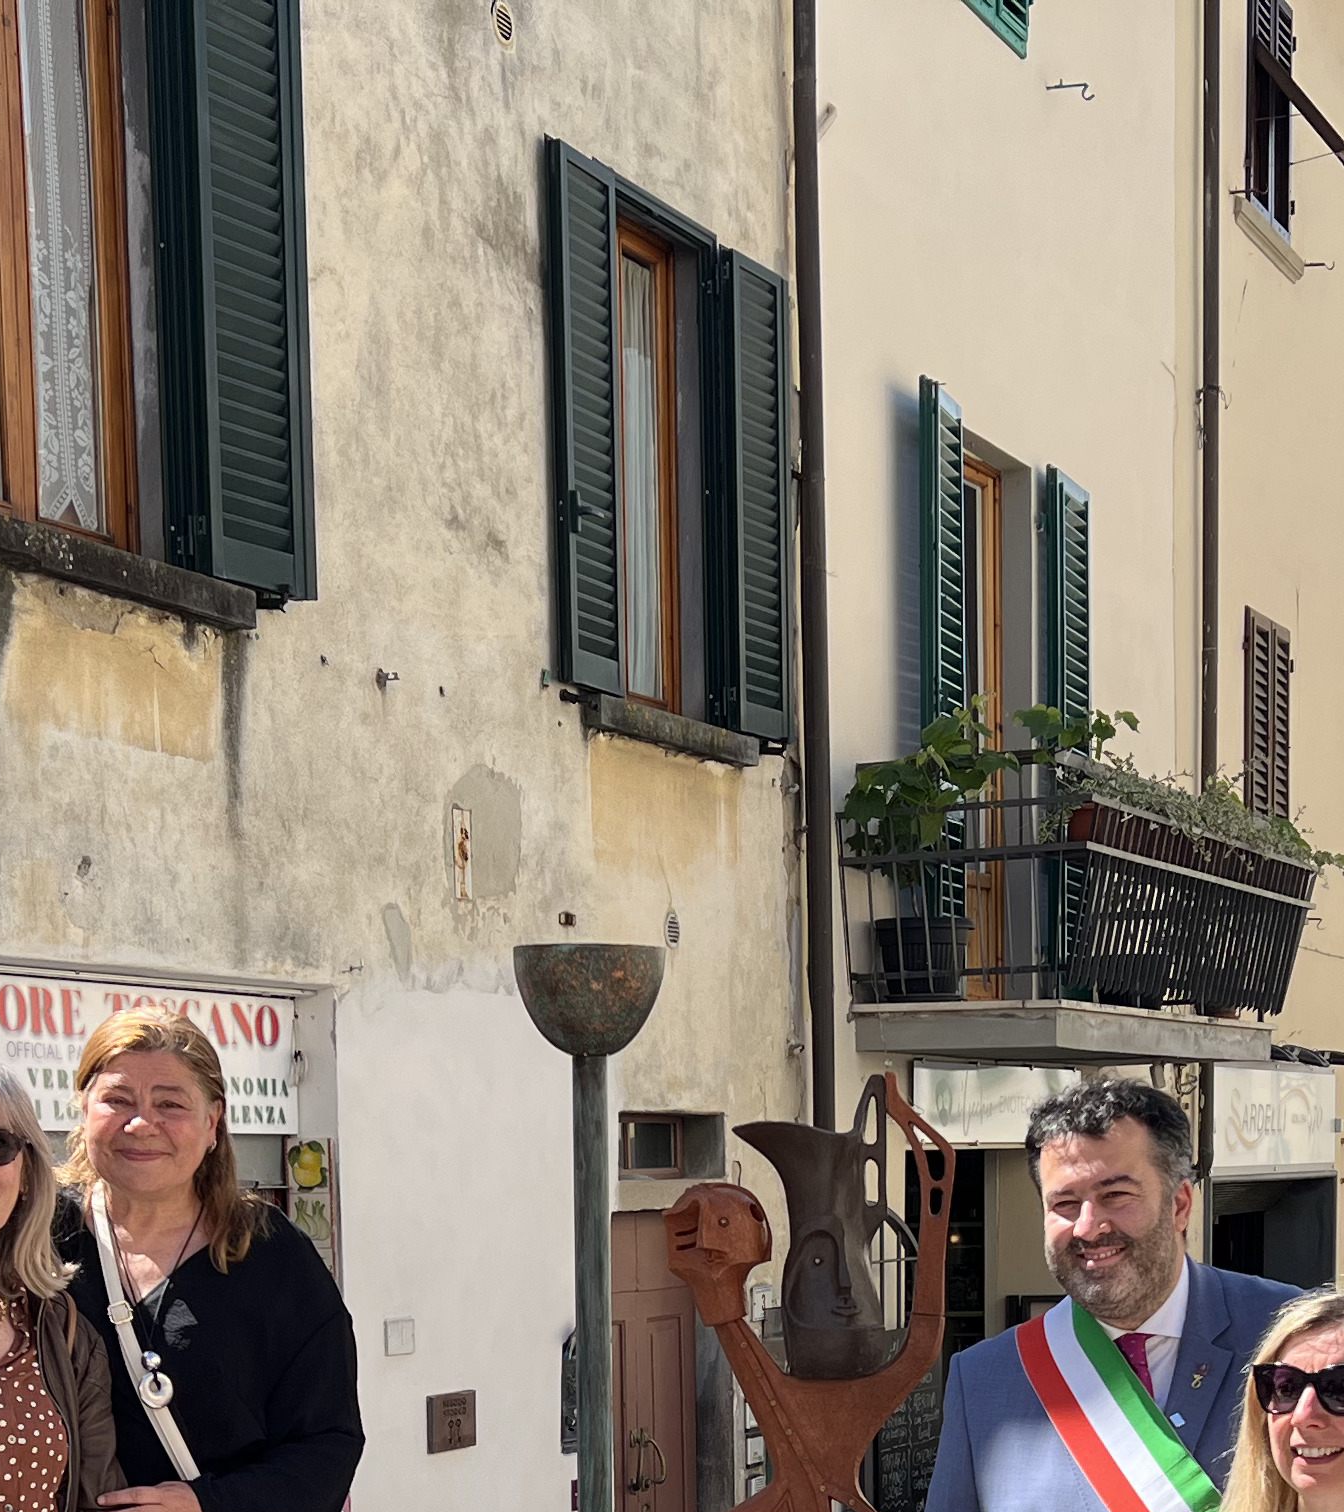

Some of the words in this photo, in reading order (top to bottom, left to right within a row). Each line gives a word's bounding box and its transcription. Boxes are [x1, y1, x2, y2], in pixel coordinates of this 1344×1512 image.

[6, 1040, 63, 1060] OFFICIAL
[223, 1076, 289, 1097] NOMIA
[229, 1104, 287, 1125] LENZA
[999, 1095, 1036, 1115] ENOTEC
